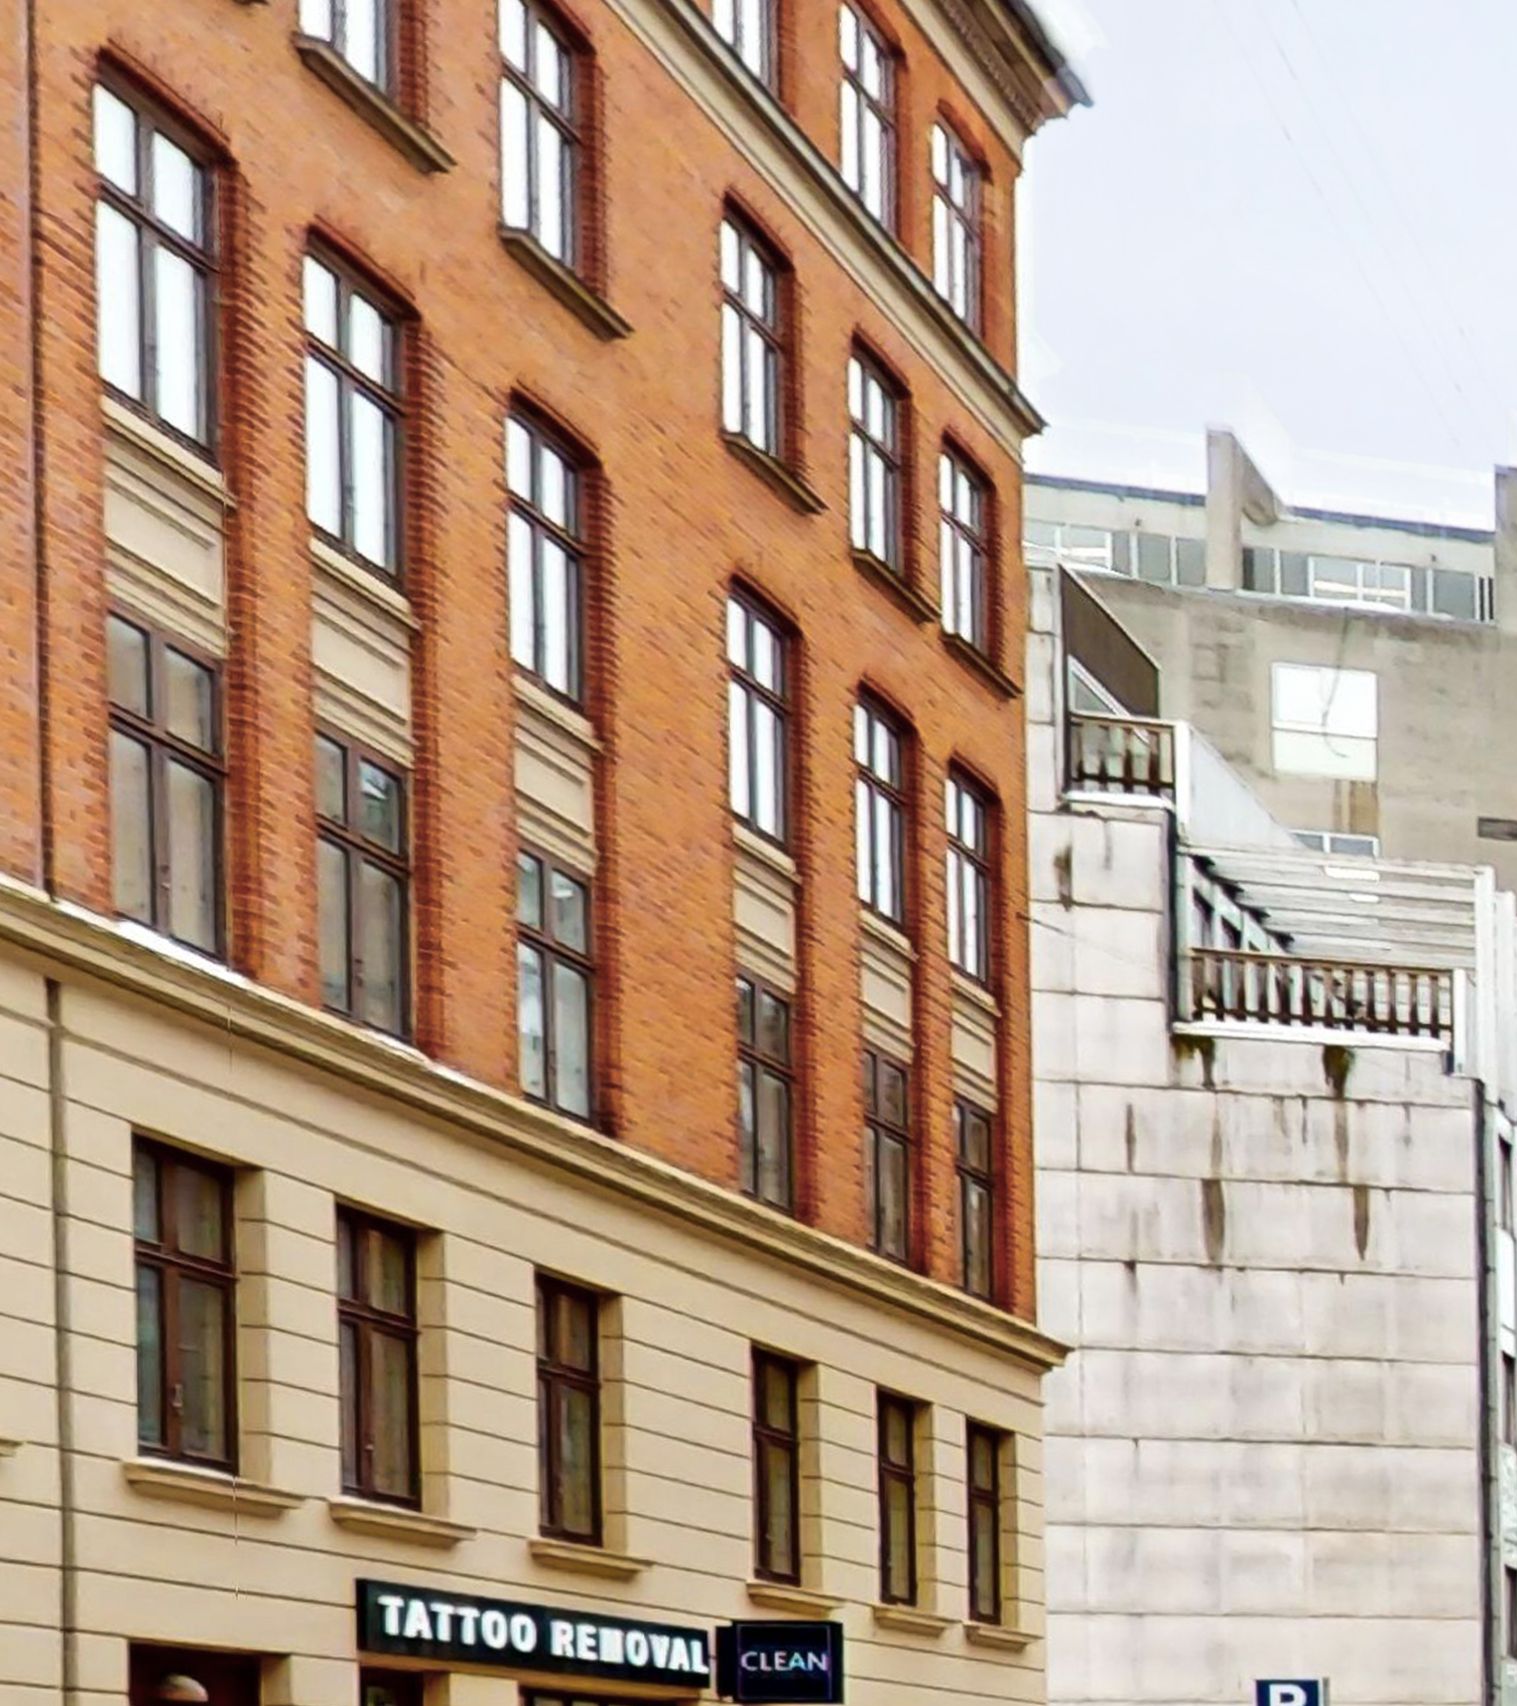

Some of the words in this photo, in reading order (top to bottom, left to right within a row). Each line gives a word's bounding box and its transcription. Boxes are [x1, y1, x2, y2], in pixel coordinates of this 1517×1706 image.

[377, 1595, 537, 1653] TATTOO
[549, 1620, 710, 1675] REMOVAL
[740, 1650, 828, 1671] CLEAN
